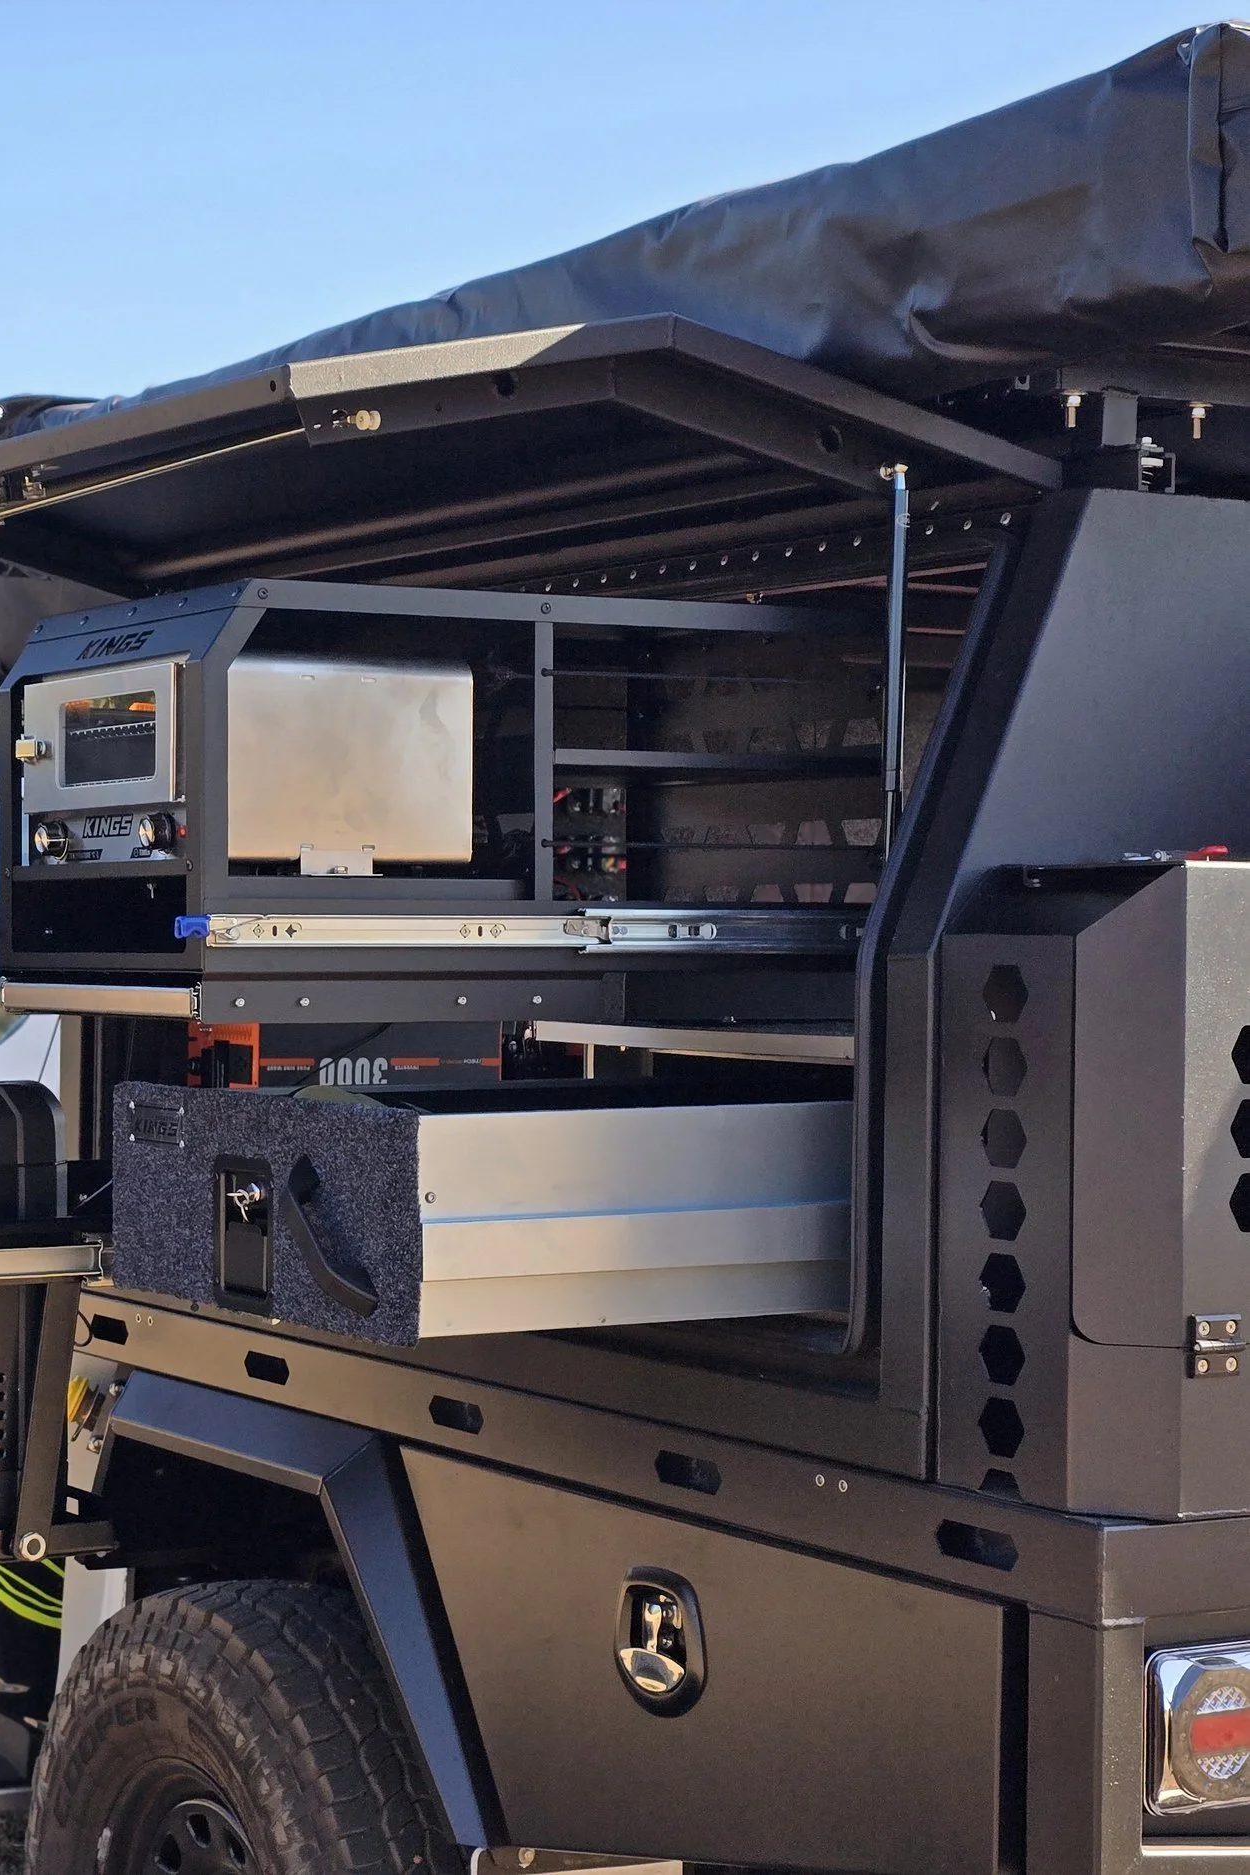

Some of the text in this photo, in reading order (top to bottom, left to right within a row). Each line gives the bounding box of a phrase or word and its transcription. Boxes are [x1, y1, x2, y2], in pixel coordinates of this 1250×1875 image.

[75, 629, 155, 661] KINGS
[82, 813, 133, 838] KINGS
[319, 1057, 388, 1085] 3000
[134, 1116, 179, 1137] KINGS
